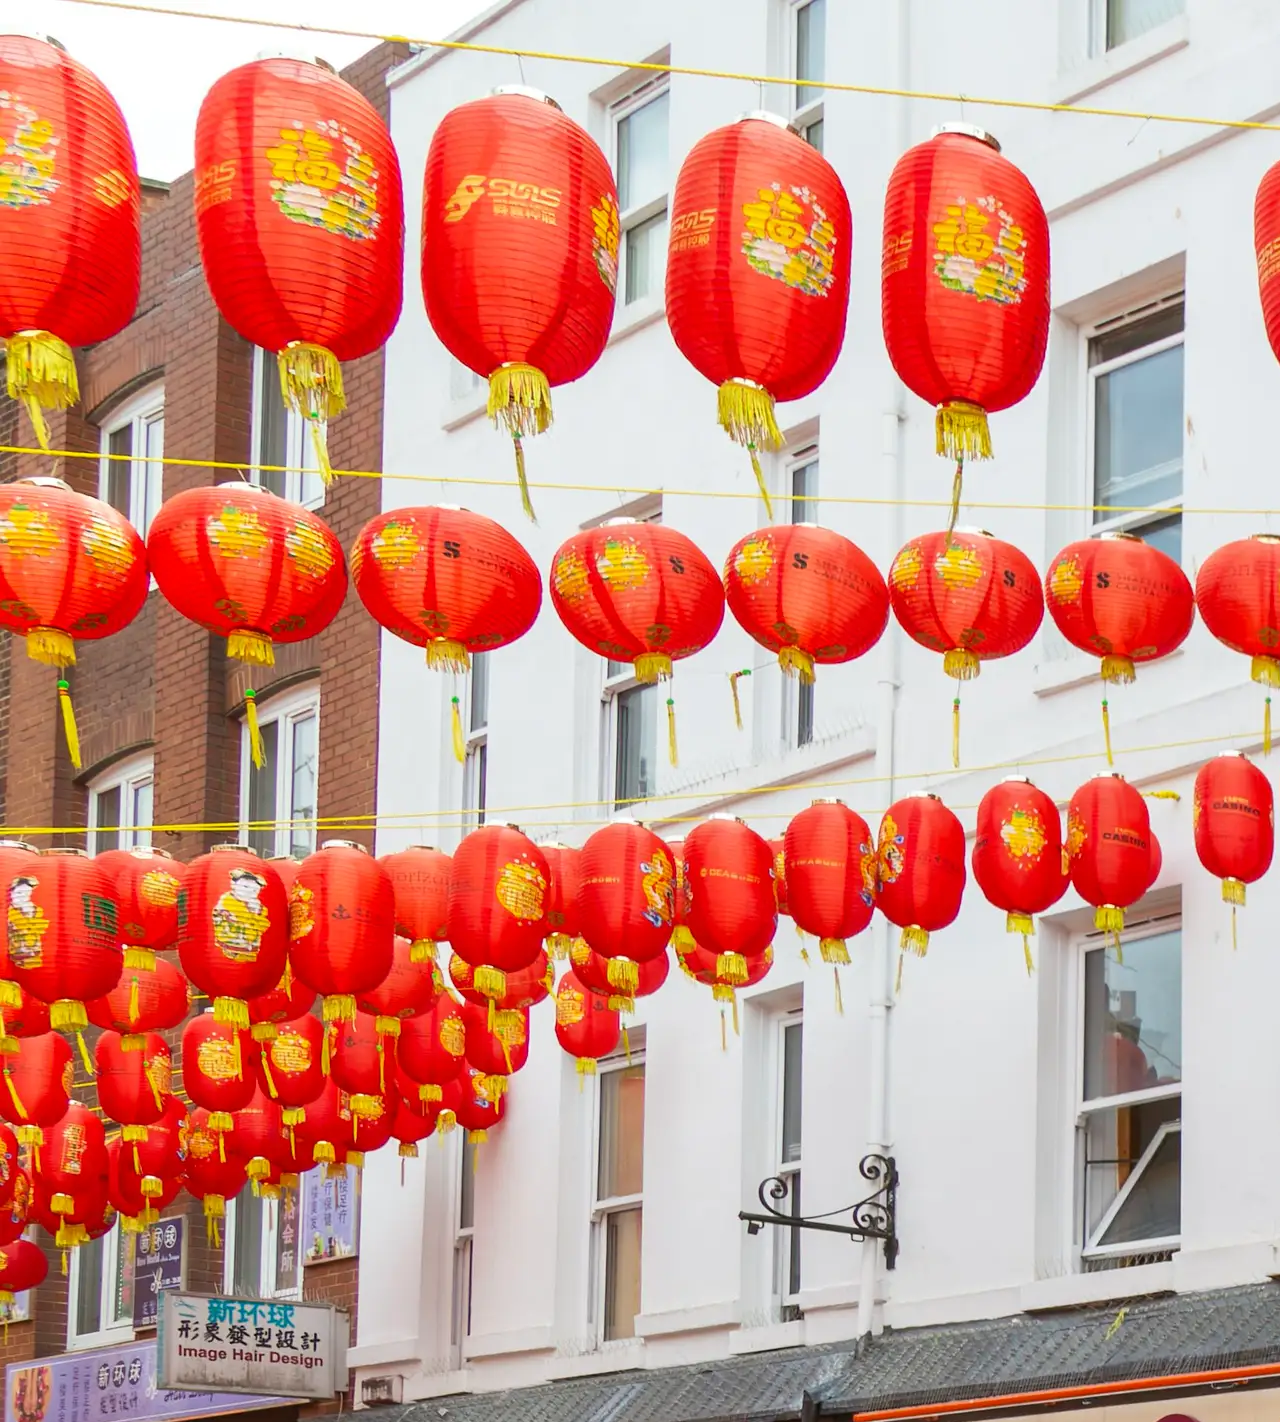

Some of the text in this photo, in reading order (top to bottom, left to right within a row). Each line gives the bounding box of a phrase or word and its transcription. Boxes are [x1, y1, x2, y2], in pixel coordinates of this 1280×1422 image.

[207, 1298, 296, 1329] 新环球
[177, 1320, 321, 1352] 形象發型設計
[177, 1344, 324, 1369] Image Hair Design
